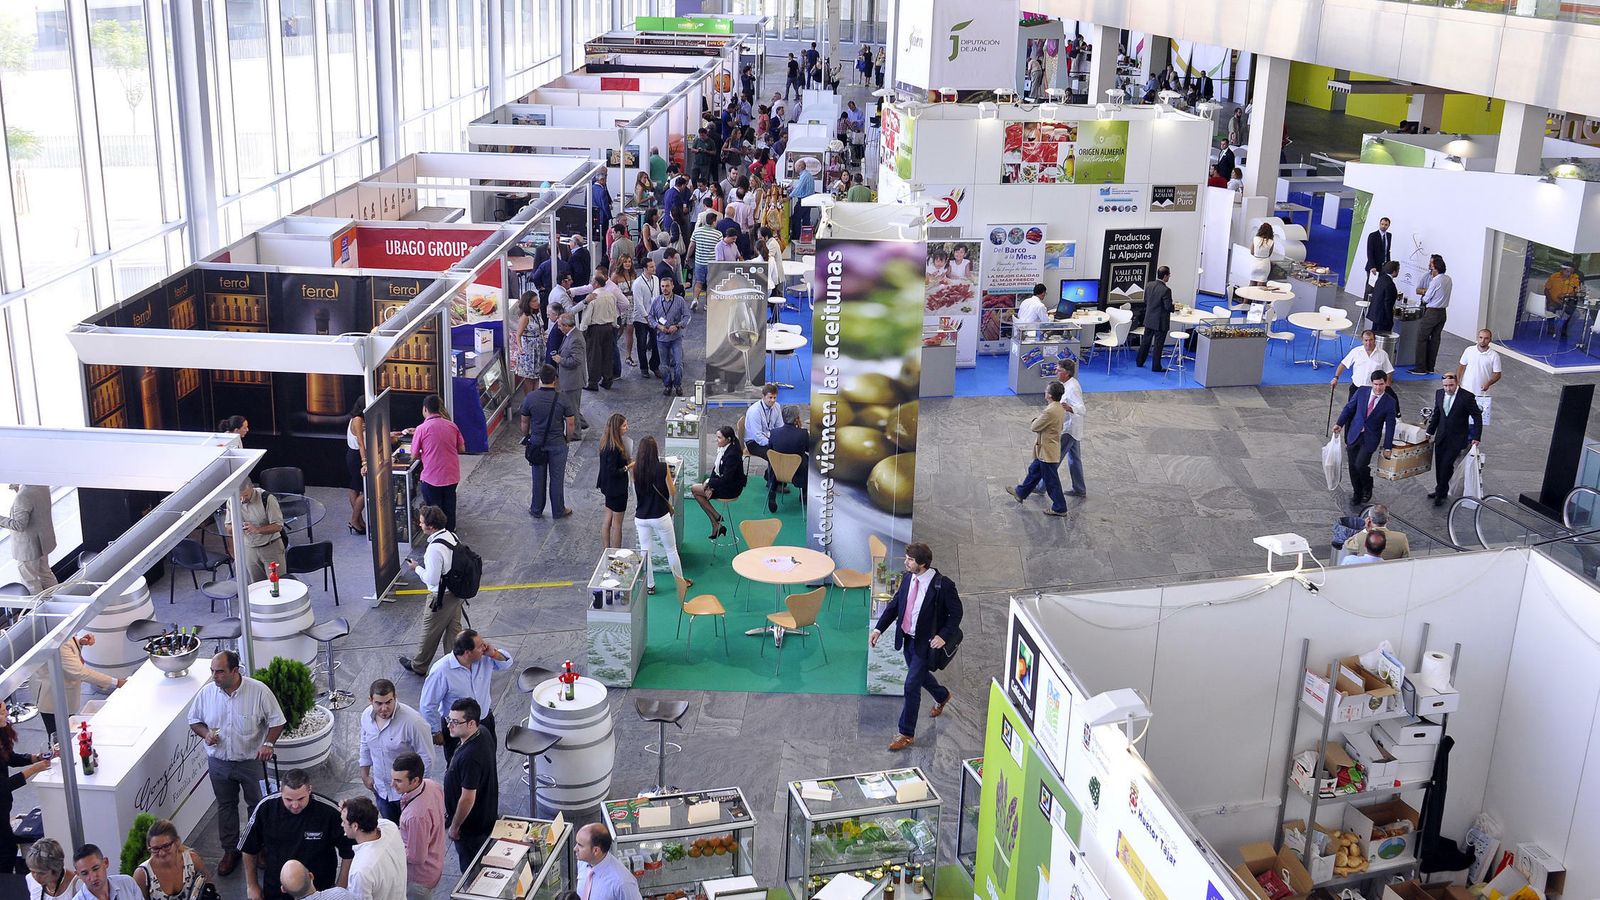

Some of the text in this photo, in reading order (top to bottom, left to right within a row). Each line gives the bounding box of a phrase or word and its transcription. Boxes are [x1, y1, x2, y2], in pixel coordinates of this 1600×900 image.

[1078, 146, 1125, 156] ORIGEN ALMERÍA
[1176, 198, 1194, 206] Puro
[1114, 233, 1151, 241] Productos
[385, 239, 468, 257] UBAGO GROUP
[1108, 241, 1155, 251] artesanos de
[1109, 250, 1152, 260] la Alpujarra
[1114, 268, 1132, 276] VALLE
[820, 250, 843, 360] aceitunas
[817, 367, 839, 395] las
[816, 401, 837, 474] vienen
[813, 478, 834, 546] donde
